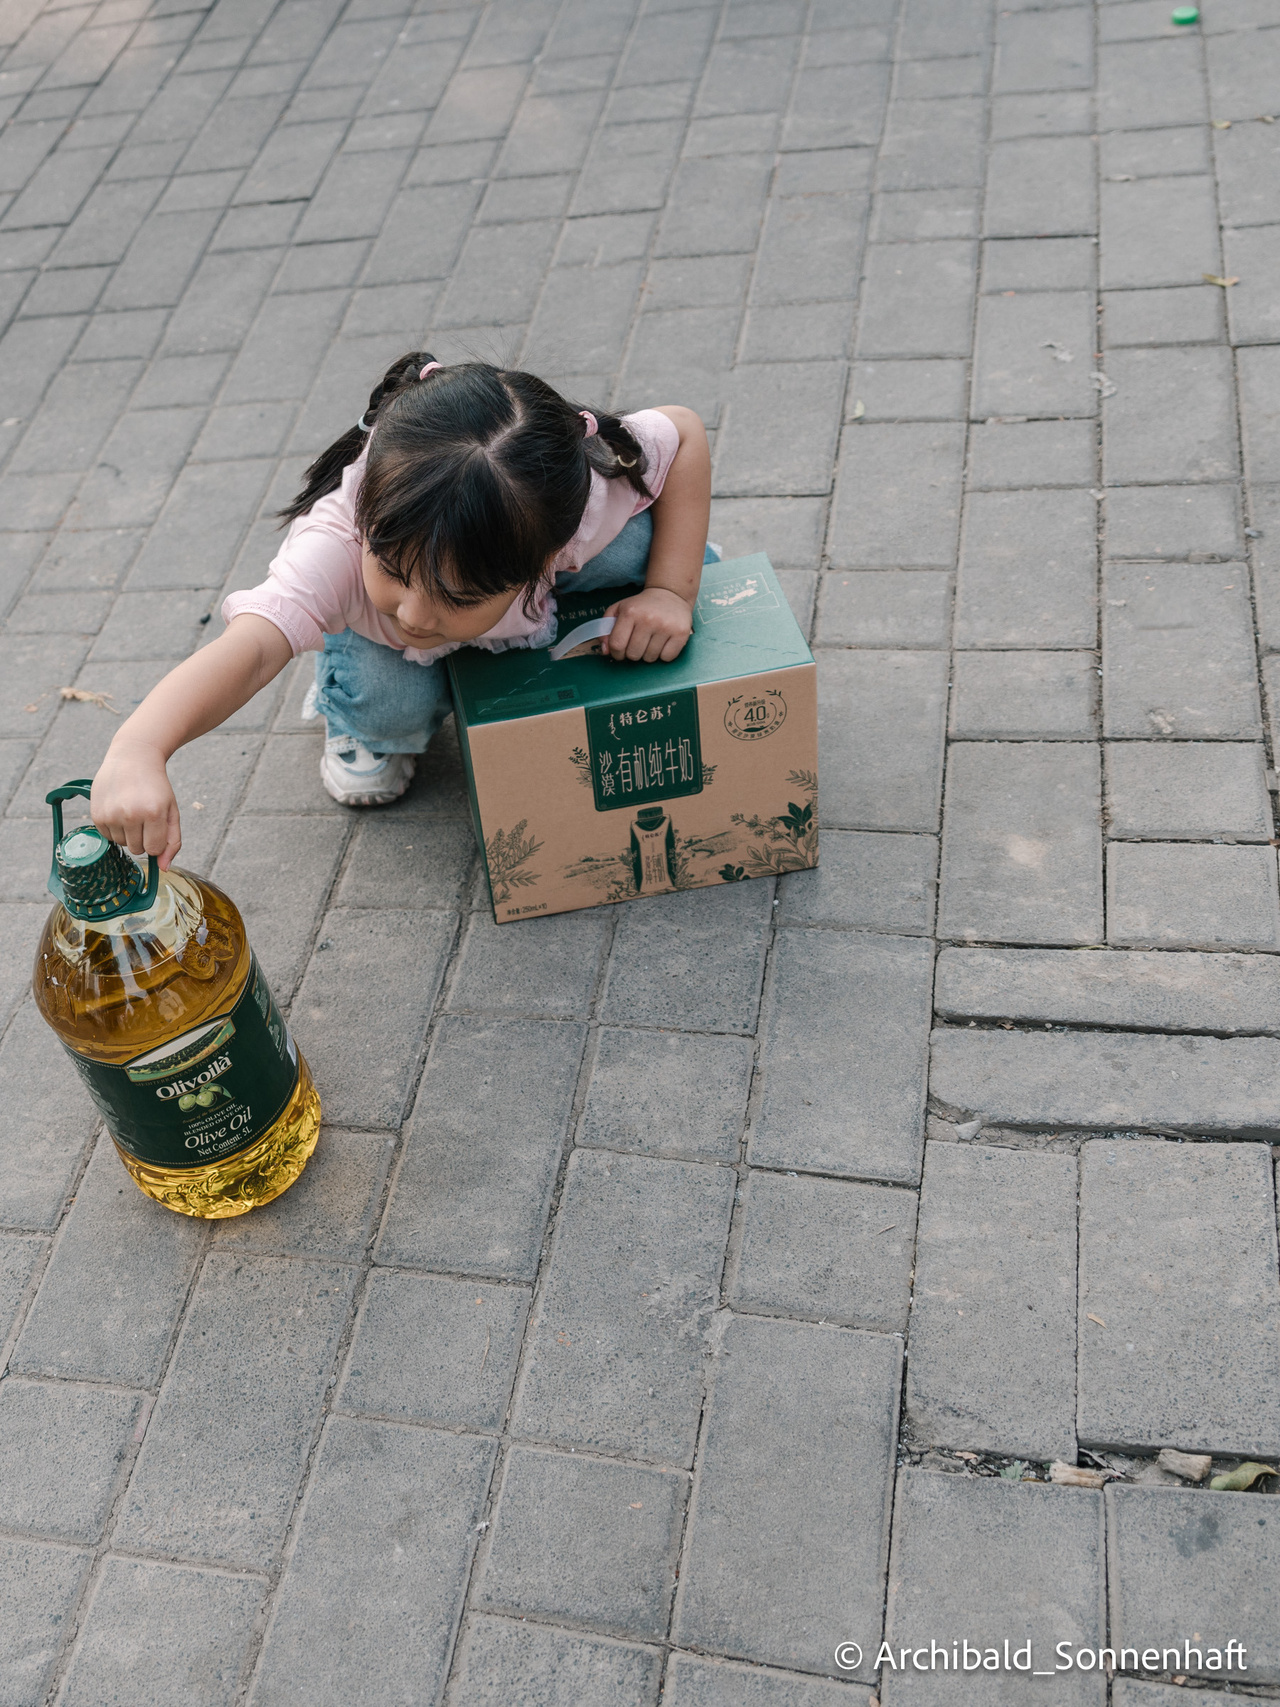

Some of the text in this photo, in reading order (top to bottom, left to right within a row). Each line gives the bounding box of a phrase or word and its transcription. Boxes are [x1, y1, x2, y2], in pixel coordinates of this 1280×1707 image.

[620, 706, 664, 726] 特仑苏
[599, 750, 616, 796] 沙漠
[616, 737, 694, 793] 有机纯牛奶
[135, 1035, 236, 1087] MEDITERRANEAN FINE QUALITY
[155, 1055, 233, 1099] Olivoilà
[183, 1103, 245, 1136] BLENDED OLIVE OIL
[184, 1127, 227, 1149] Olive
[230, 1105, 253, 1131] Oil
[188, 1120, 205, 1130] 100%
[205, 1109, 226, 1123] OLIVE
[225, 1103, 237, 1113] OIL
[197, 1138, 212, 1157] Net
[212, 1132, 242, 1154] Content:
[242, 1126, 253, 1138] 5L
